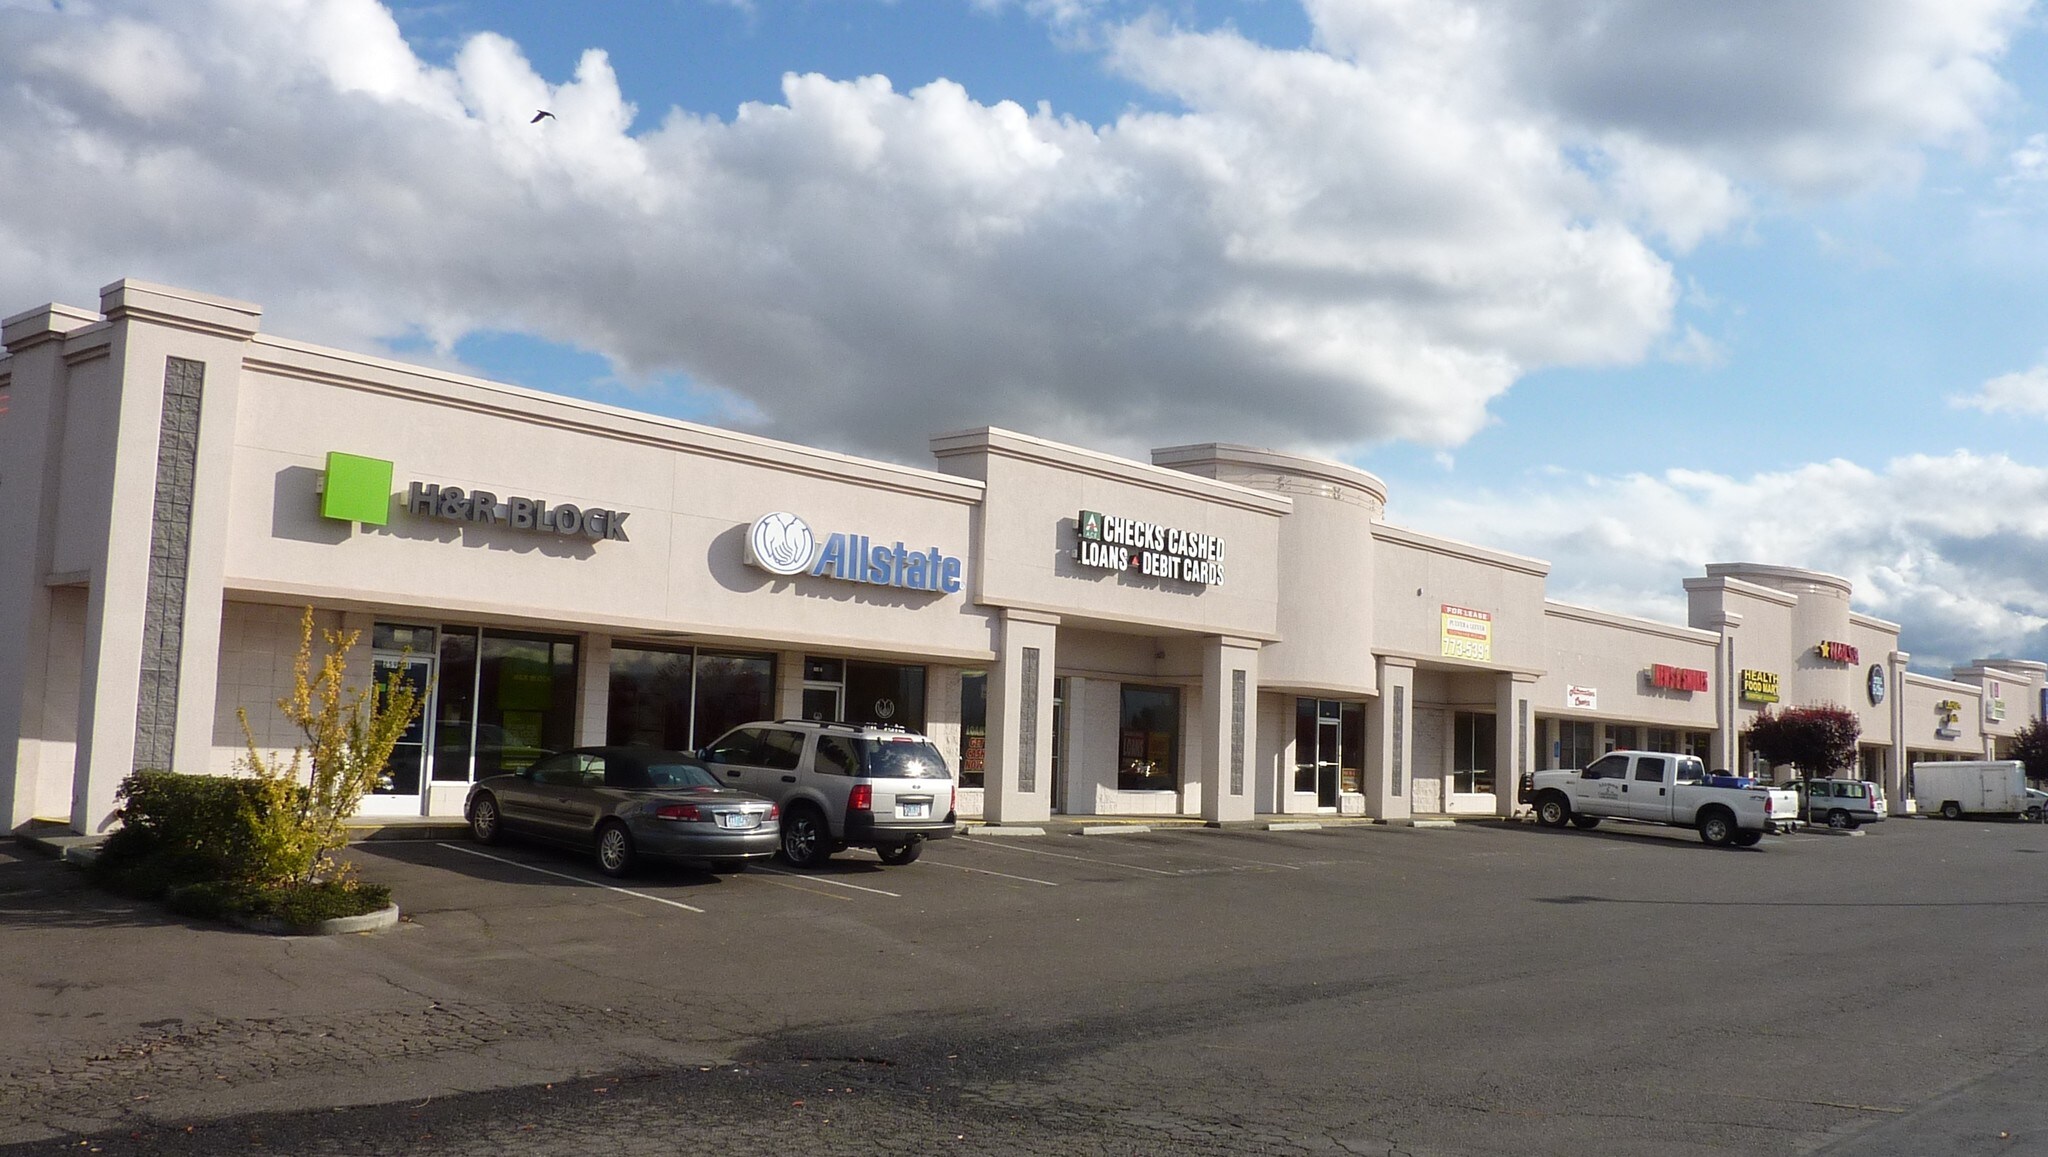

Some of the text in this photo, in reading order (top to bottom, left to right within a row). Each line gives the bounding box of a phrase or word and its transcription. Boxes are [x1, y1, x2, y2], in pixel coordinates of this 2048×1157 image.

[409, 481, 631, 542] H&R BLOCK
[1103, 514, 1225, 562] CHECKS CASHED
[811, 532, 961, 594] Allstate
[1081, 540, 1225, 586] LOANS DEBIT CARDS
[1446, 606, 1487, 620] FOR LEASE
[1442, 637, 1490, 661] 773-5391
[1744, 670, 1779, 684] HEALTH
[1744, 680, 1779, 695] FOOD MART
